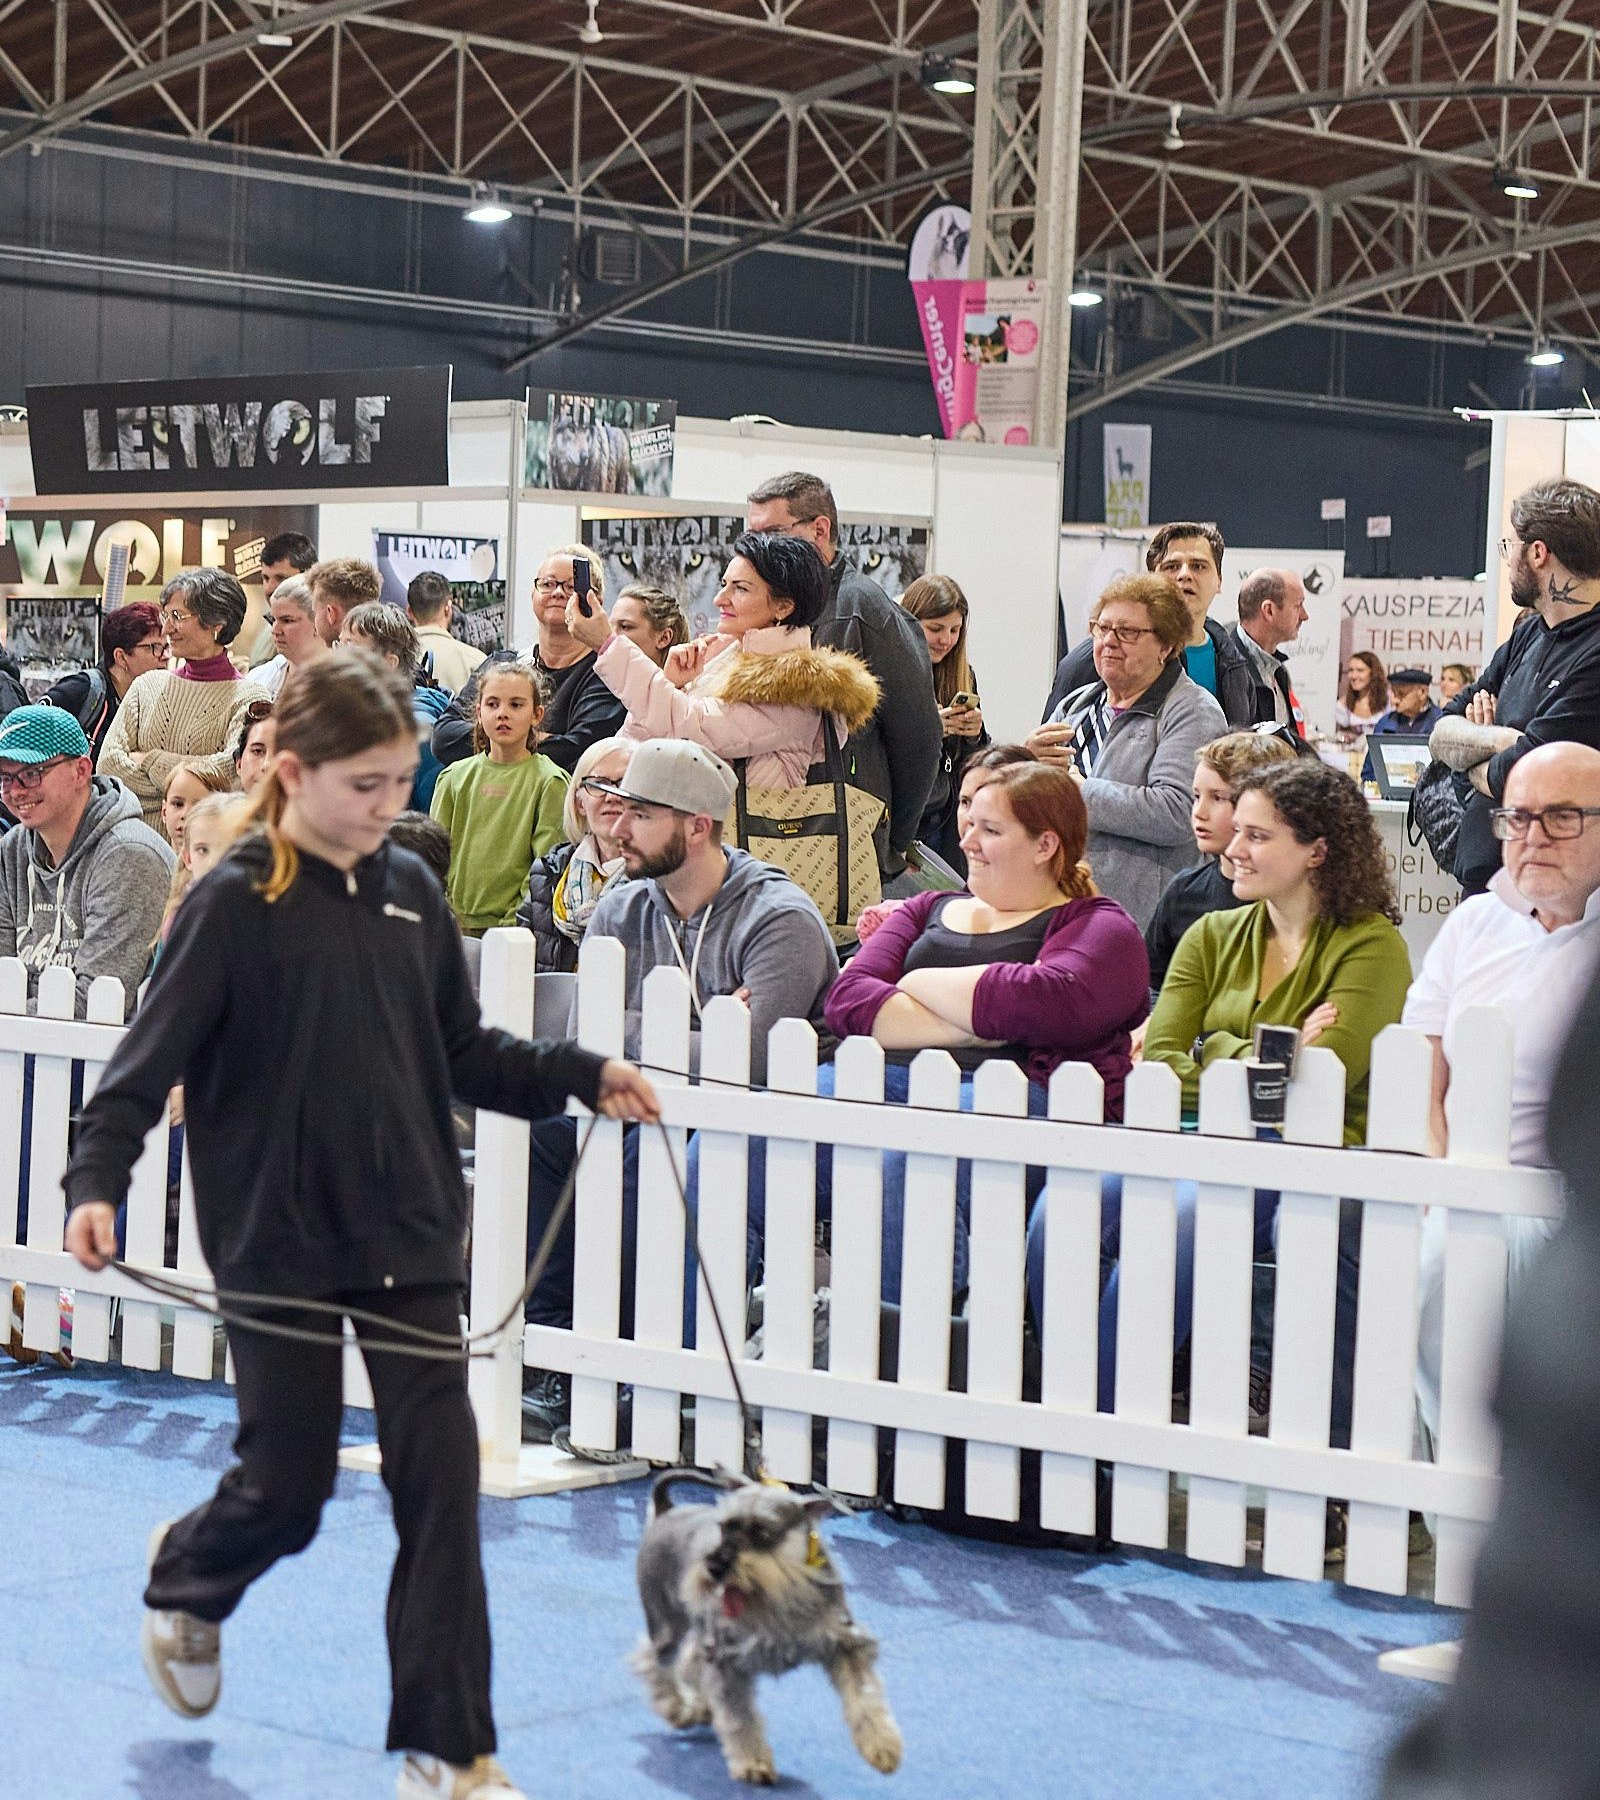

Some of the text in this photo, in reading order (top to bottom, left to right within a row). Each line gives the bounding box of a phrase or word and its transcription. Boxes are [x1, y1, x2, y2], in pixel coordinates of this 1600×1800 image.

[547, 393, 658, 432] LEITWOLF
[83, 395, 387, 472] LEITWOLF
[591, 517, 733, 546] LEITWOLF
[1366, 629, 1483, 651] TIERNAH
[778, 822, 803, 830] GUESS
[784, 839, 804, 863] GUESS
[851, 829, 869, 851] GUESS
[808, 857, 825, 880] GUESS
[850, 851, 870, 873] GUESS
[850, 873, 870, 895] GUESS
[849, 894, 869, 917] GUESS
